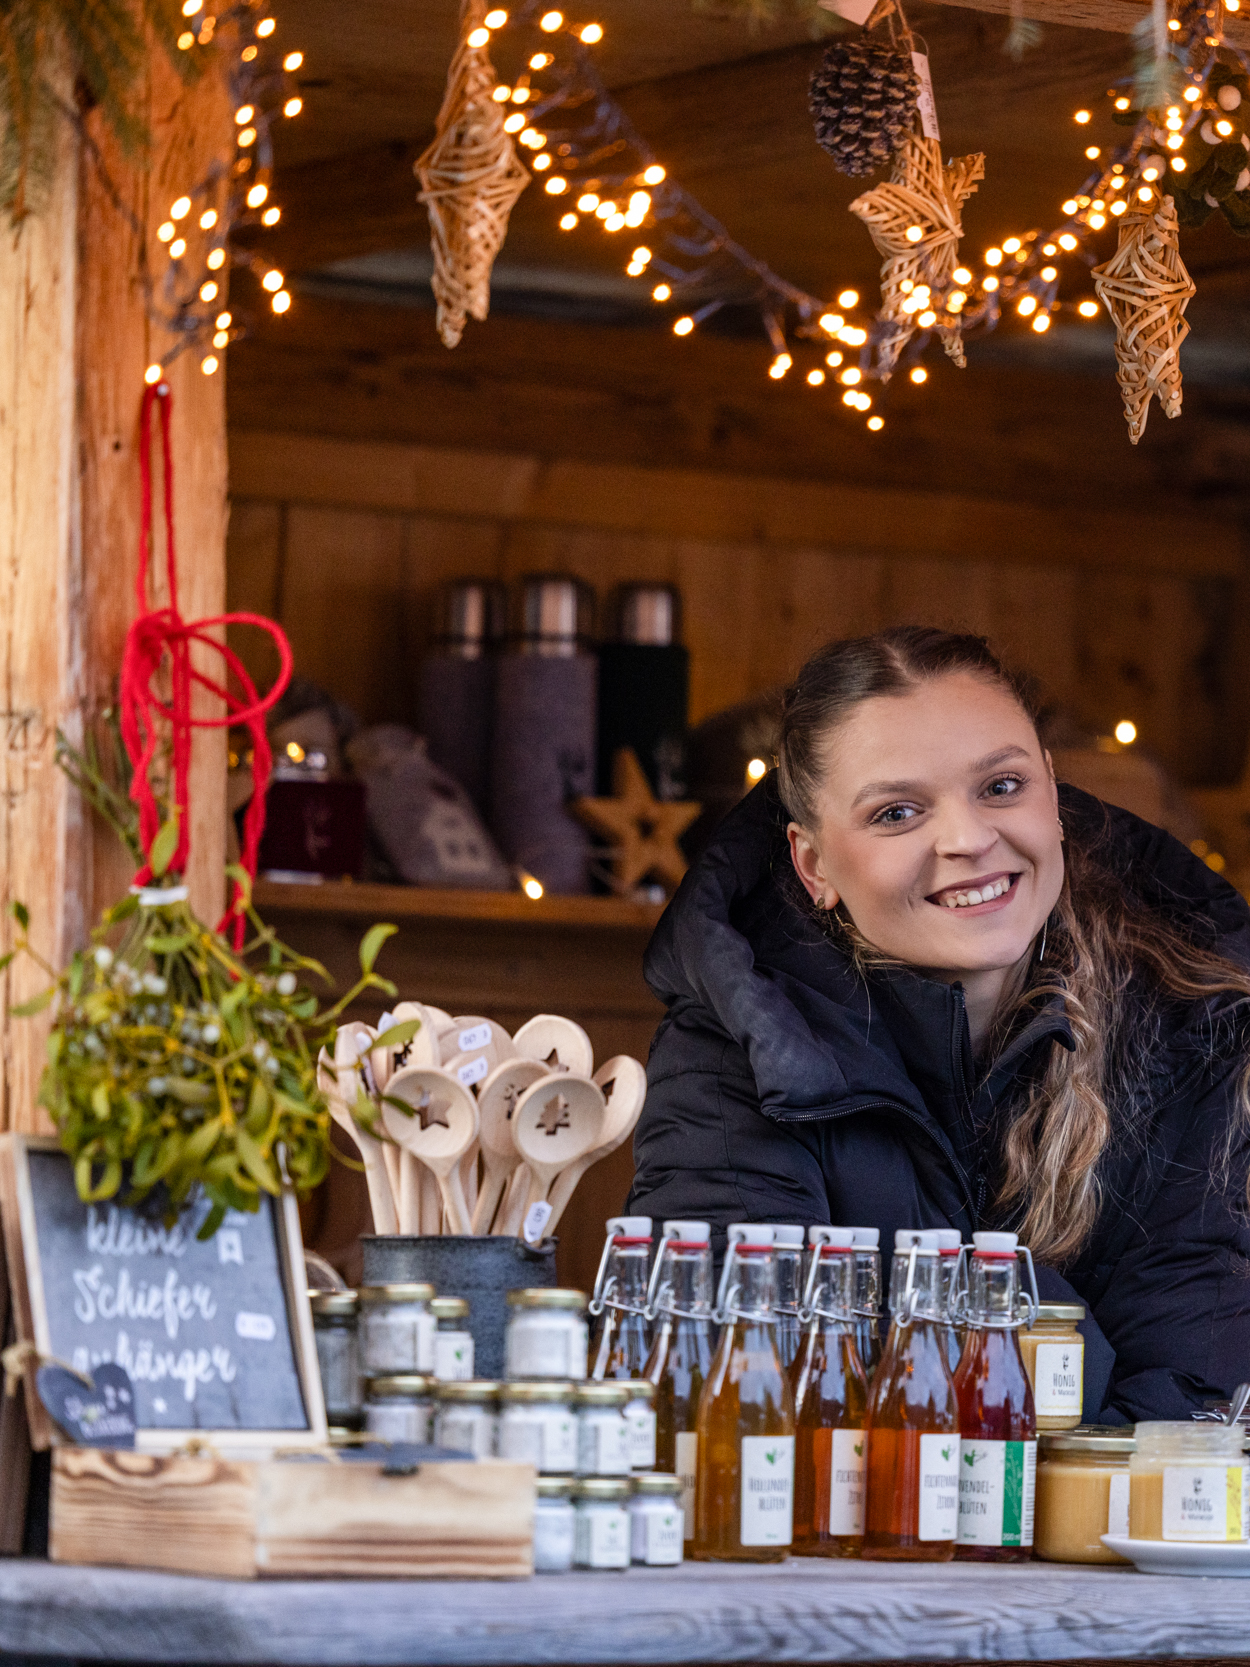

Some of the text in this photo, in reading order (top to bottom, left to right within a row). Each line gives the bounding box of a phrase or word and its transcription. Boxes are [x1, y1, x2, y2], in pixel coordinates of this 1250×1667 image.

[87, 1205, 187, 1257] kleine
[72, 1264, 218, 1340] Schiefer
[1053, 1373, 1076, 1388] HONIG
[958, 1479, 995, 1495] VENDEL-
[1181, 1496, 1213, 1512] HONIG
